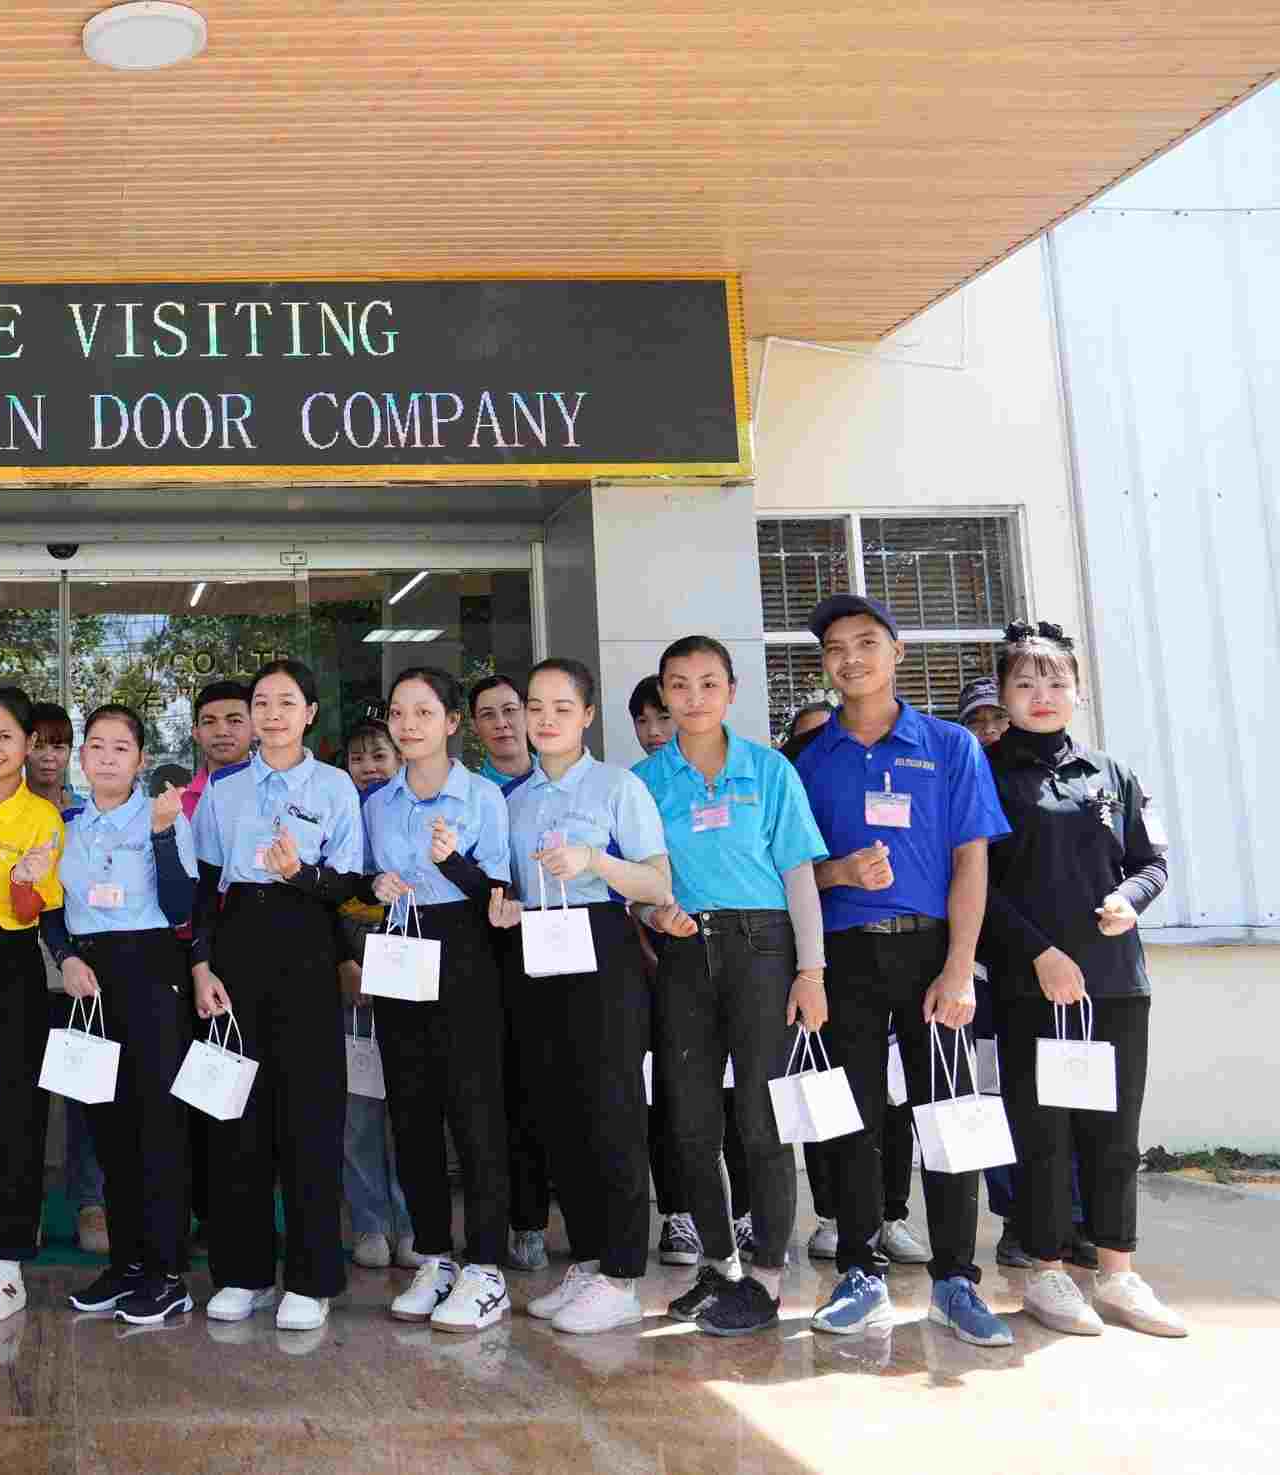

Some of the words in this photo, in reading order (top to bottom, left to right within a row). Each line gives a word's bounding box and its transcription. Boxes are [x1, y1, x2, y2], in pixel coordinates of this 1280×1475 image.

[70, 300, 400, 359] VISITING
[90, 393, 257, 451] DOOR
[300, 390, 588, 450] COMPANY
